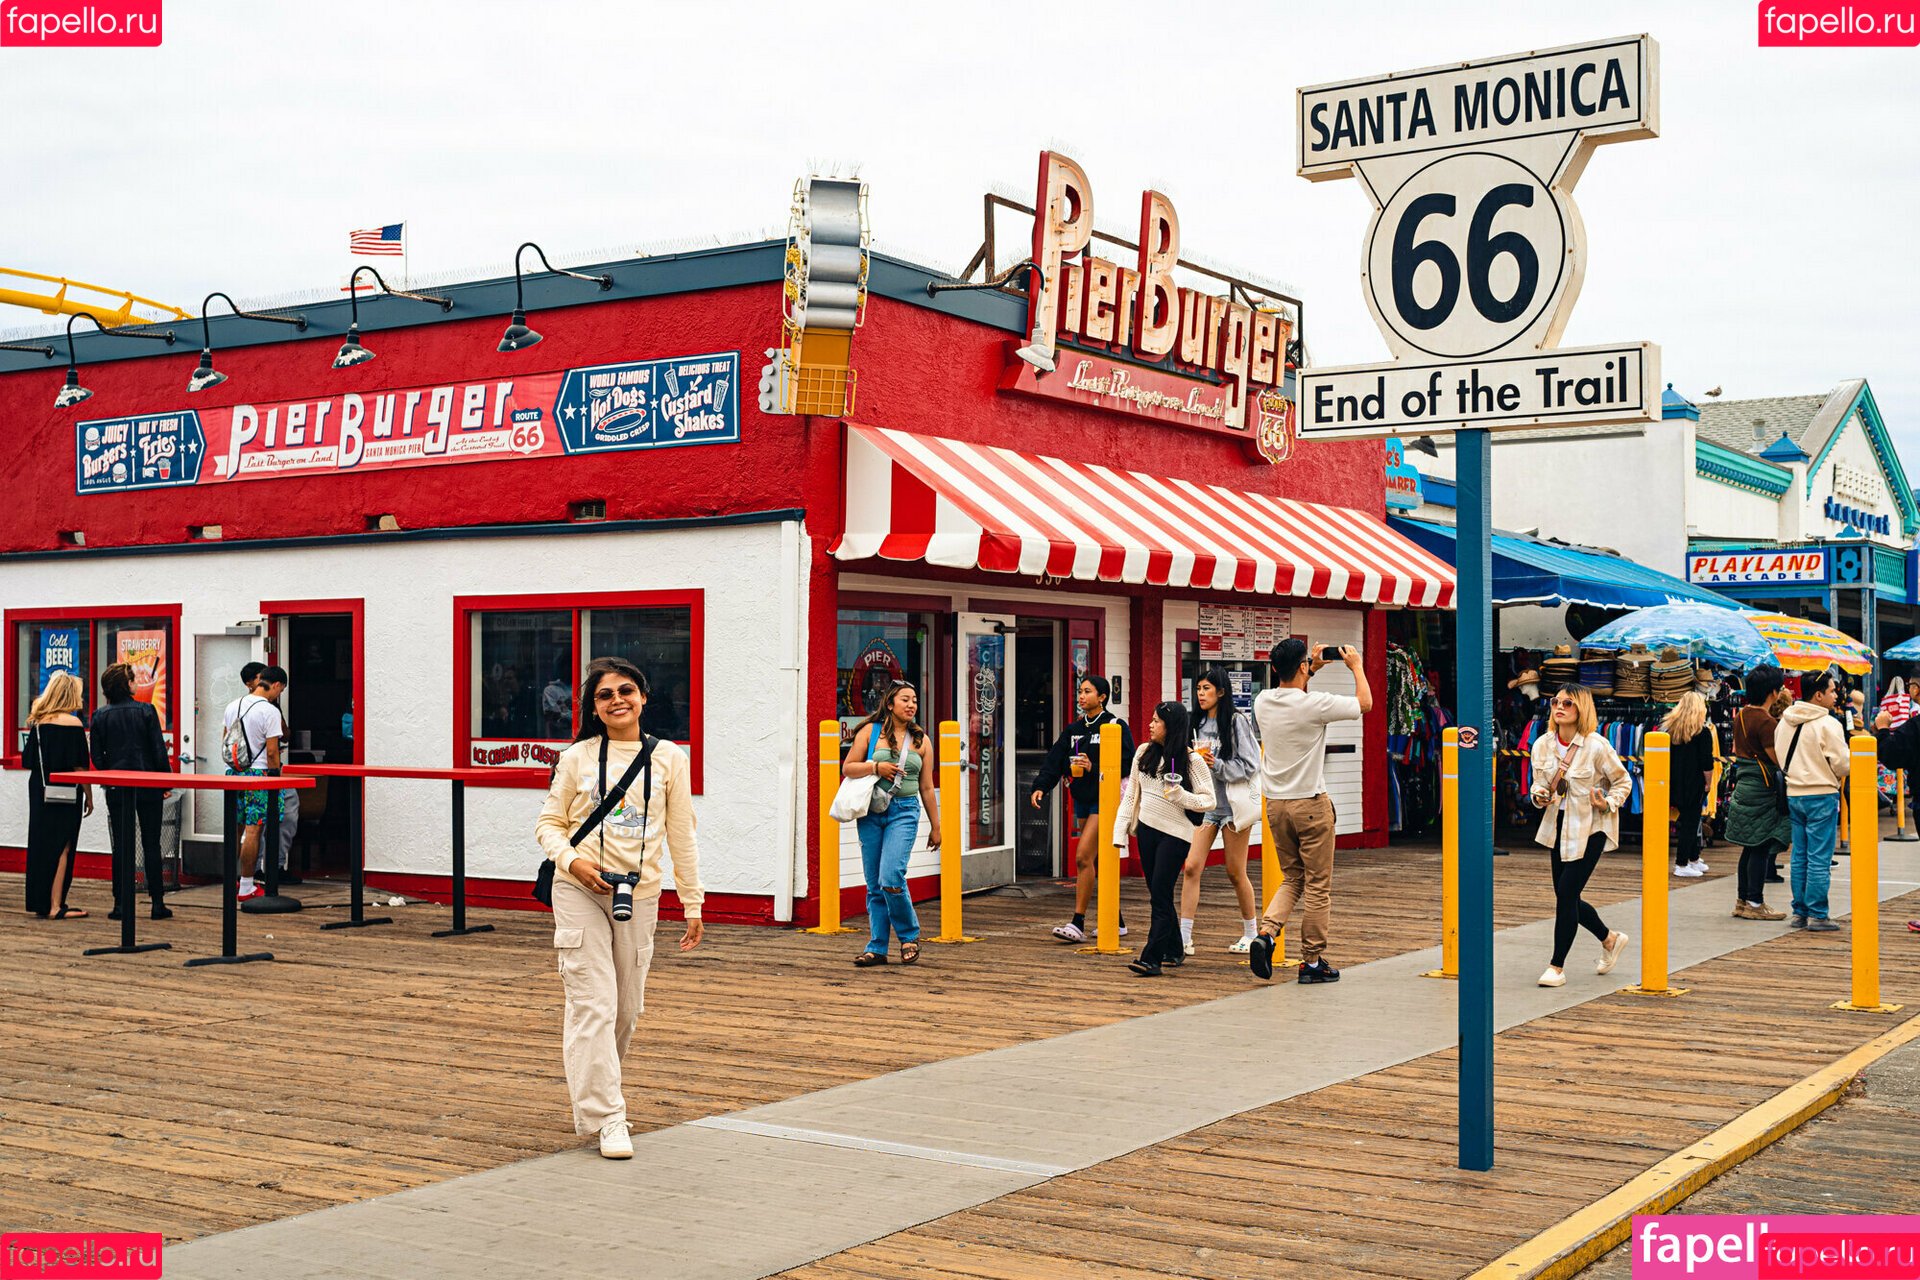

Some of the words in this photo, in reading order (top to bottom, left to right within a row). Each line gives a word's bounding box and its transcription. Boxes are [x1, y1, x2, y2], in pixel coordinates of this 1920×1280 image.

[1310, 87, 1438, 152] SANTA
[1454, 58, 1631, 133] MONICA
[1391, 183, 1540, 330] 66
[589, 372, 616, 389] WORLD
[617, 369, 650, 386] FAMOUS
[678, 363, 710, 377] DELICIOUS
[711, 361, 731, 374] TREAT
[1314, 376, 1385, 423] End
[1401, 371, 1443, 418] of
[1456, 369, 1521, 414] the
[1535, 356, 1628, 408] Trail
[590, 392, 612, 432] Hot
[612, 386, 647, 408] Dogs
[661, 383, 714, 422] Custard
[515, 410, 539, 421] ROUTE
[674, 411, 725, 439] Shakes
[101, 423, 129, 444] JUICY
[138, 421, 151, 435] HOT
[513, 425, 540, 448] 66
[595, 432, 629, 442] GRIDDLED
[629, 421, 650, 438] CRISP
[1261, 417, 1288, 450] 66
[82, 443, 127, 478] Burgers
[138, 434, 177, 466] Fries
[244, 455, 265, 469] Last
[266, 454, 295, 469] Burger
[308, 451, 334, 463] Land
[365, 447, 384, 458] SANTA
[385, 444, 406, 456] MONICA
[407, 443, 422, 454] PIER
[1693, 554, 1822, 574] PLAYLAND
[1712, 572, 1802, 582] ARCADE
[49, 633, 69, 647] Cold
[121, 638, 161, 652] STRAWBERRY
[46, 647, 73, 669] BEER!
[864, 650, 891, 668] PIER
[473, 747, 488, 765] ICE
[488, 744, 519, 766] CREAM
[981, 748, 991, 825] SHAKES
